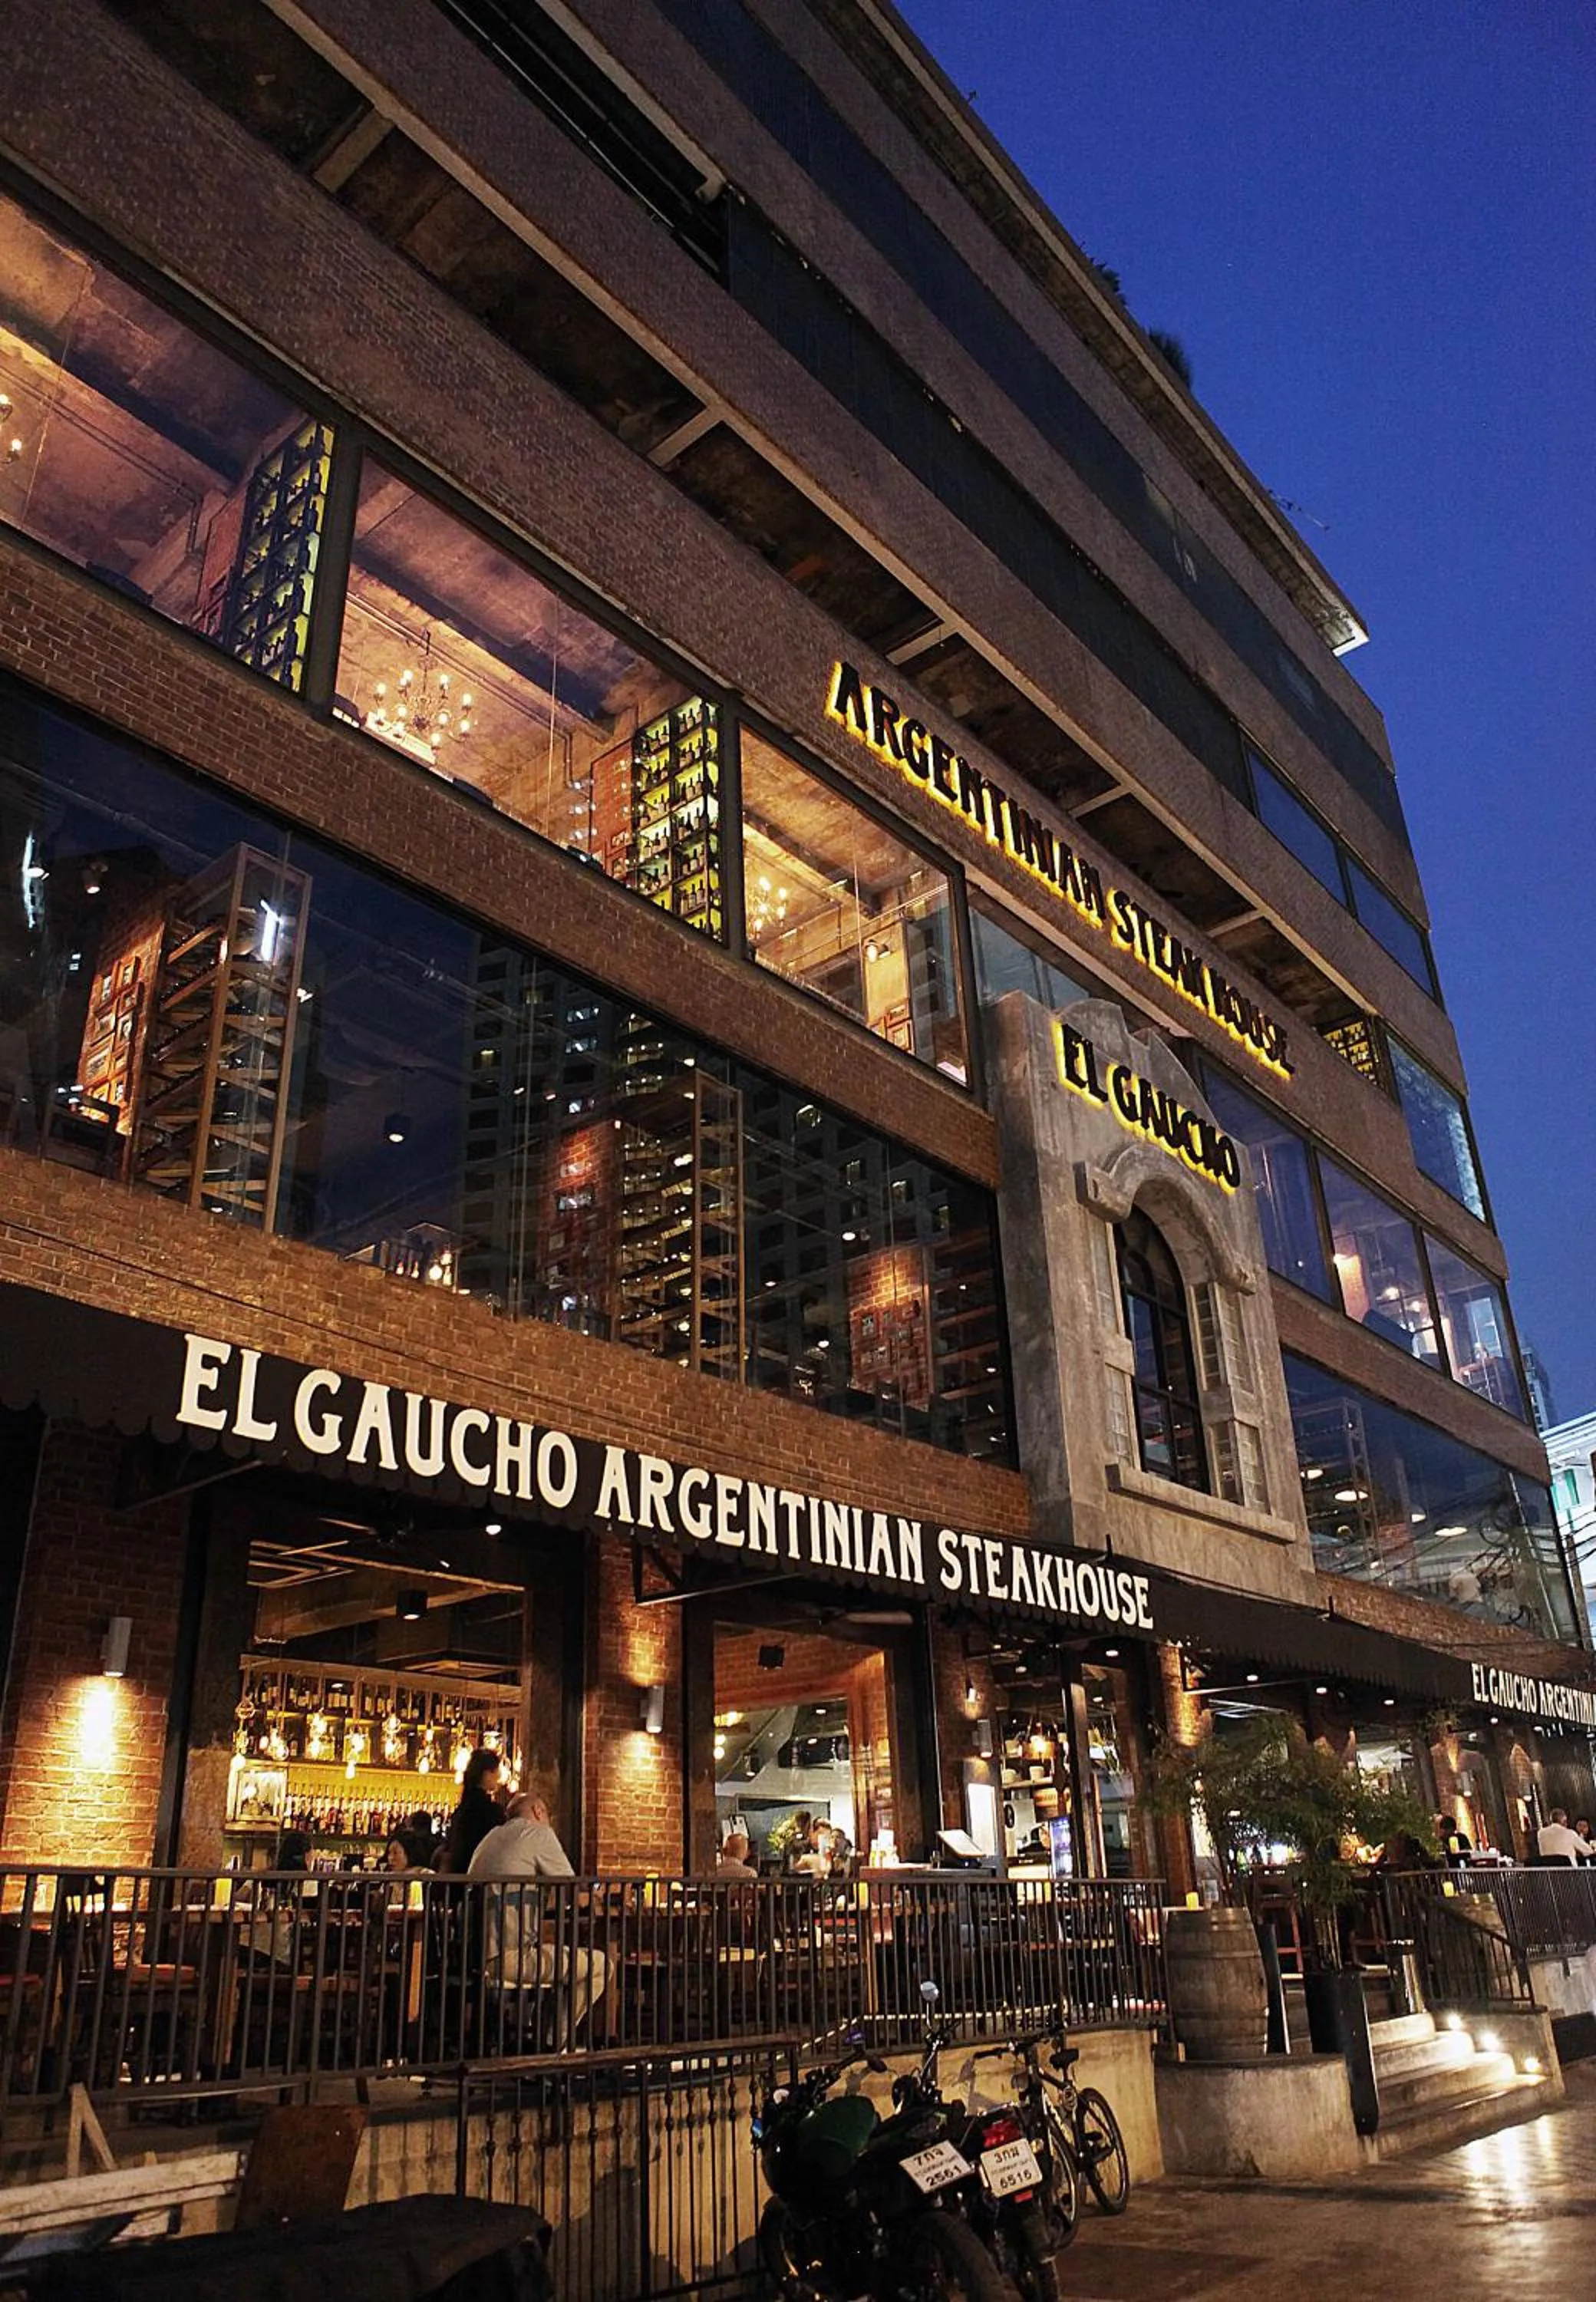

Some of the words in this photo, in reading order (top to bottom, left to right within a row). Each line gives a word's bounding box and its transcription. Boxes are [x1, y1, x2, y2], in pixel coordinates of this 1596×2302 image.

[827, 661, 1107, 924] ARGENTINIAN
[1107, 889, 1295, 1078] STEAKHOUSE
[1054, 1021, 1108, 1107] EL
[1108, 1064, 1241, 1193] GAUCHO
[176, 1333, 277, 1441] EL
[294, 1368, 578, 1509] GAUCHO
[594, 1445, 925, 1585] ARGENTINIAN
[938, 1529, 1154, 1630] STEAKHOUSE
[1472, 1663, 1489, 1703] EL
[1489, 1667, 1537, 1713] GAUCHO
[925, 2165, 961, 2186] 2561
